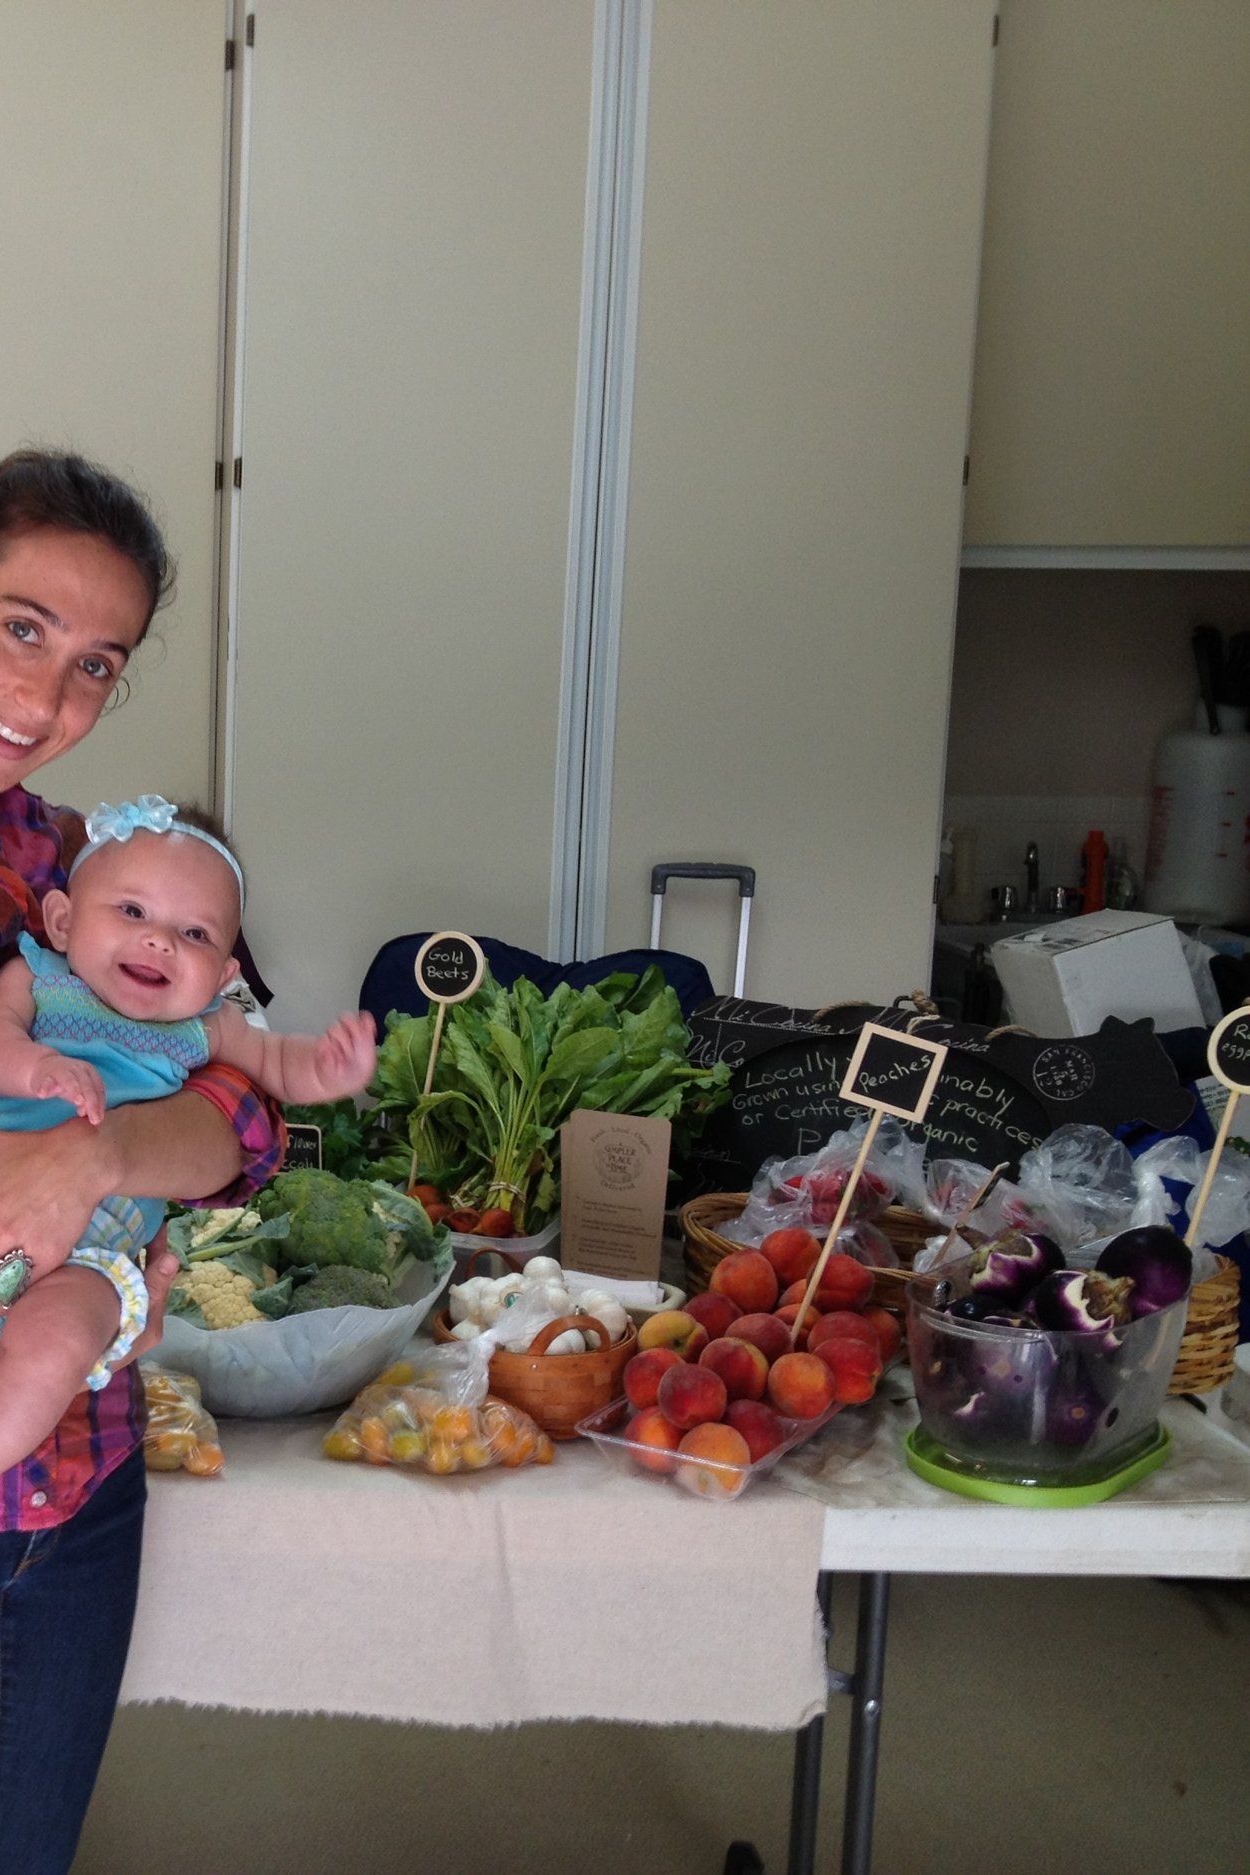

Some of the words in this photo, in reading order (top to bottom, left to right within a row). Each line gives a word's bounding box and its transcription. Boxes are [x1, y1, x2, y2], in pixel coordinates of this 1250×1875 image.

[428, 947, 464, 965] Gold
[426, 965, 470, 980] Beets
[746, 1051, 836, 1088] Locally
[732, 1088, 789, 1110] Grown
[796, 1080, 840, 1097] usin
[940, 1099, 1044, 1152] practices
[742, 1112, 765, 1125] or
[287, 1135, 317, 1150] flower
[281, 1157, 314, 1169] ccoli
